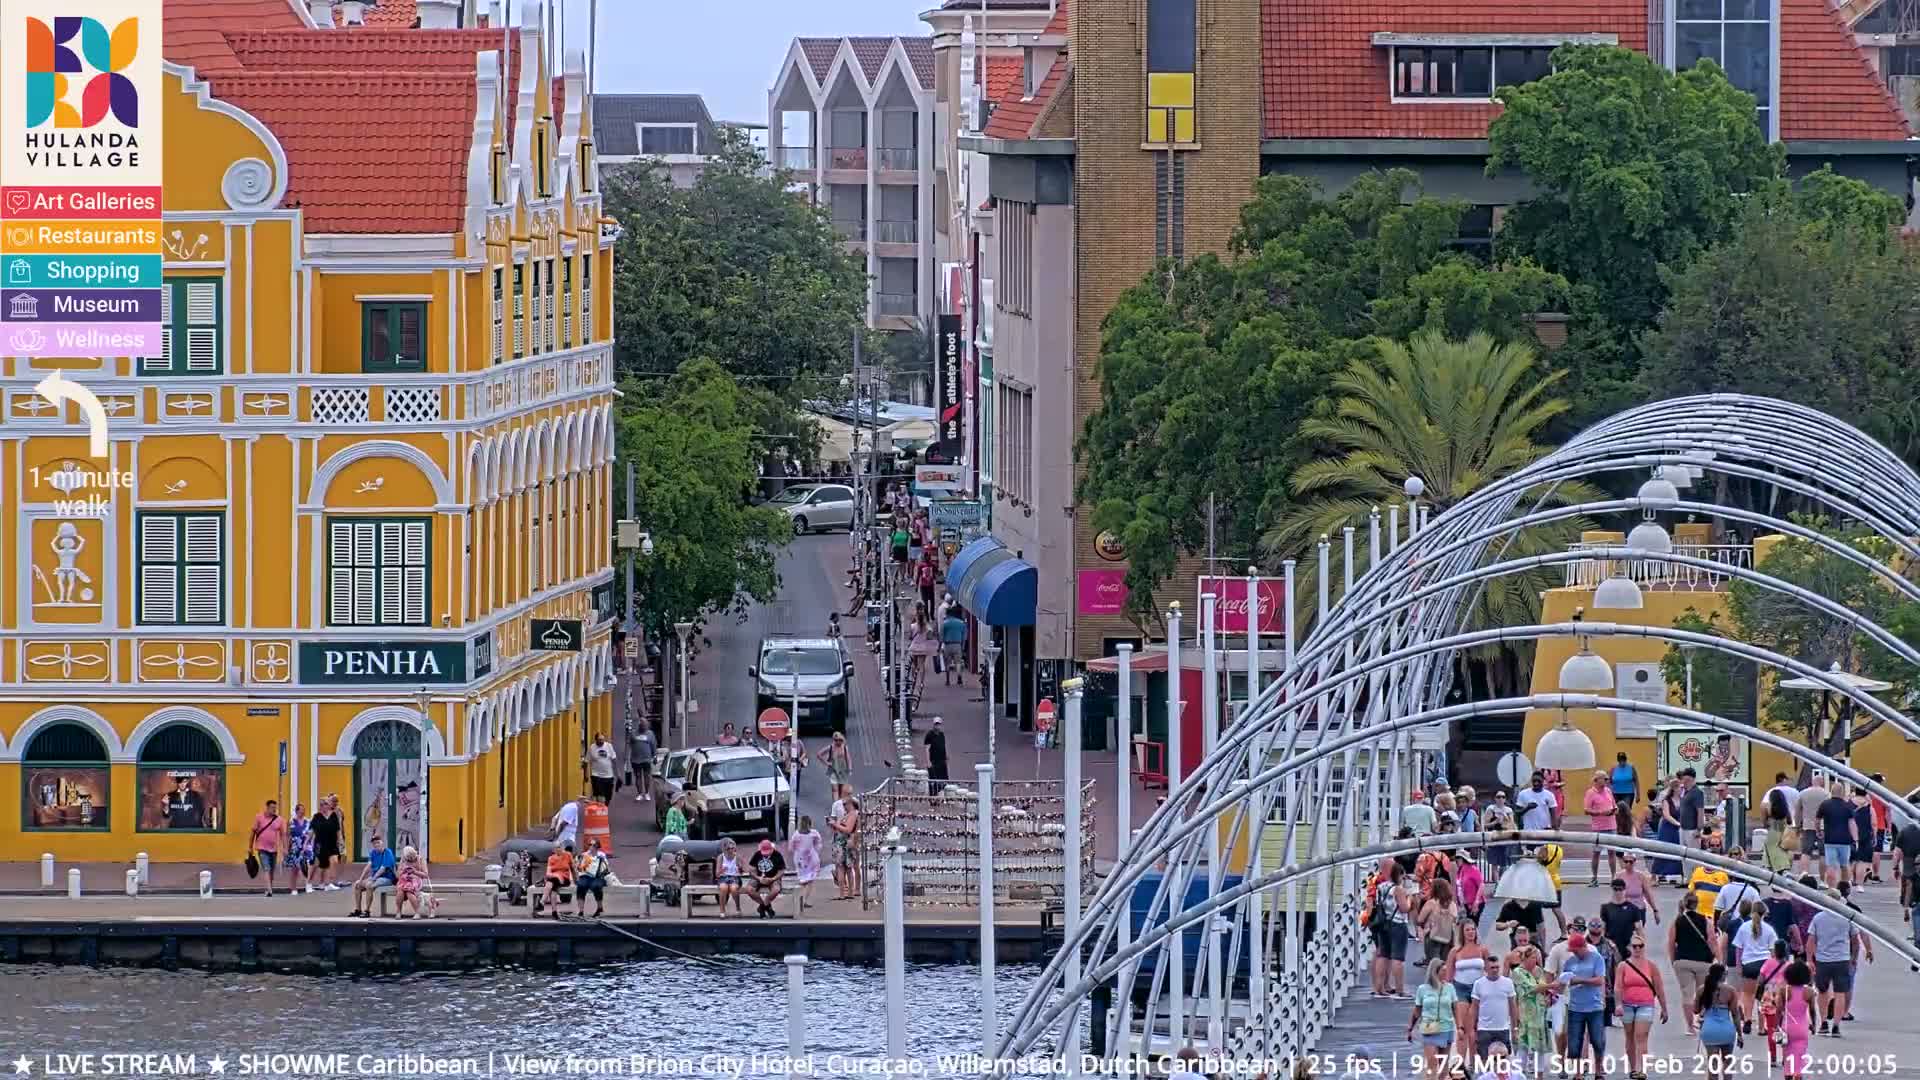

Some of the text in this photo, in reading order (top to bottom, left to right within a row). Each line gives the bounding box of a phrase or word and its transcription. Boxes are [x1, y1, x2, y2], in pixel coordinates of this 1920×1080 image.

[946, 332, 957, 357] foot
[947, 420, 957, 440] the
[324, 650, 442, 675] PENHA
